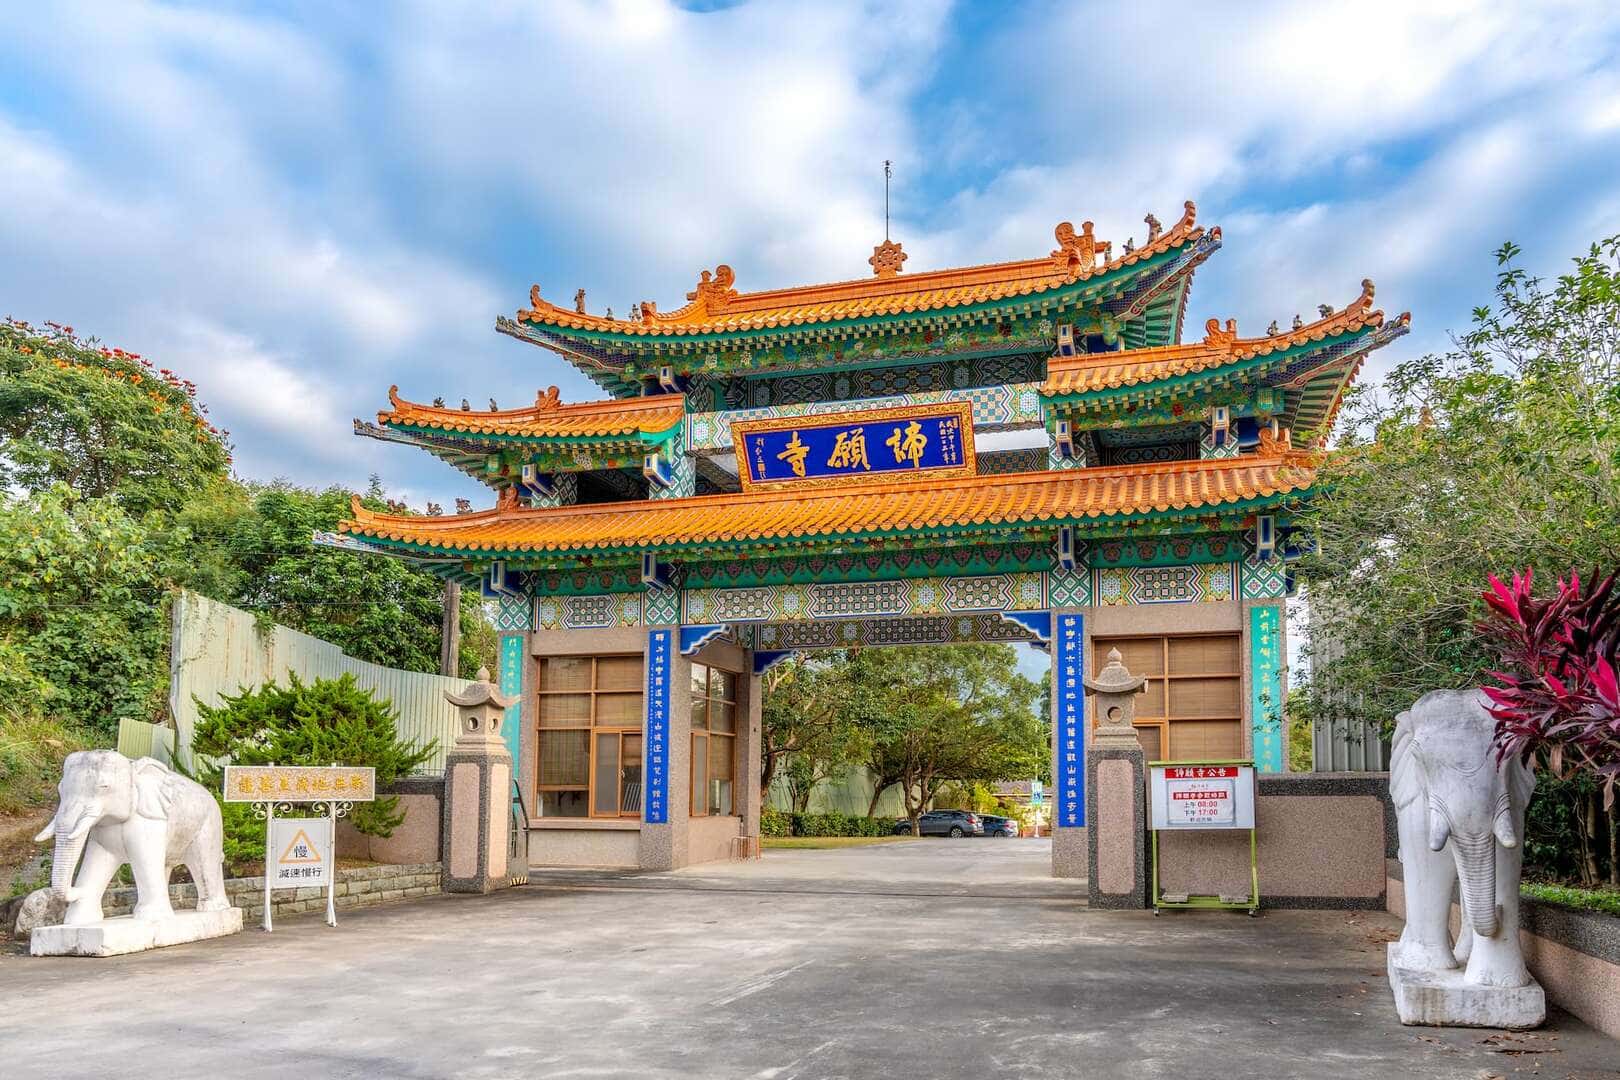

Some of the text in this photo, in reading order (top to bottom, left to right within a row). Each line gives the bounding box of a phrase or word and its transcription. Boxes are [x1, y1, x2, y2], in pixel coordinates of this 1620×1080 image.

[777, 421, 928, 477] 諦願寺
[1174, 767, 1227, 778] 諦願寺公告
[294, 845, 308, 859] 慢
[278, 867, 323, 879] 減速慢行
